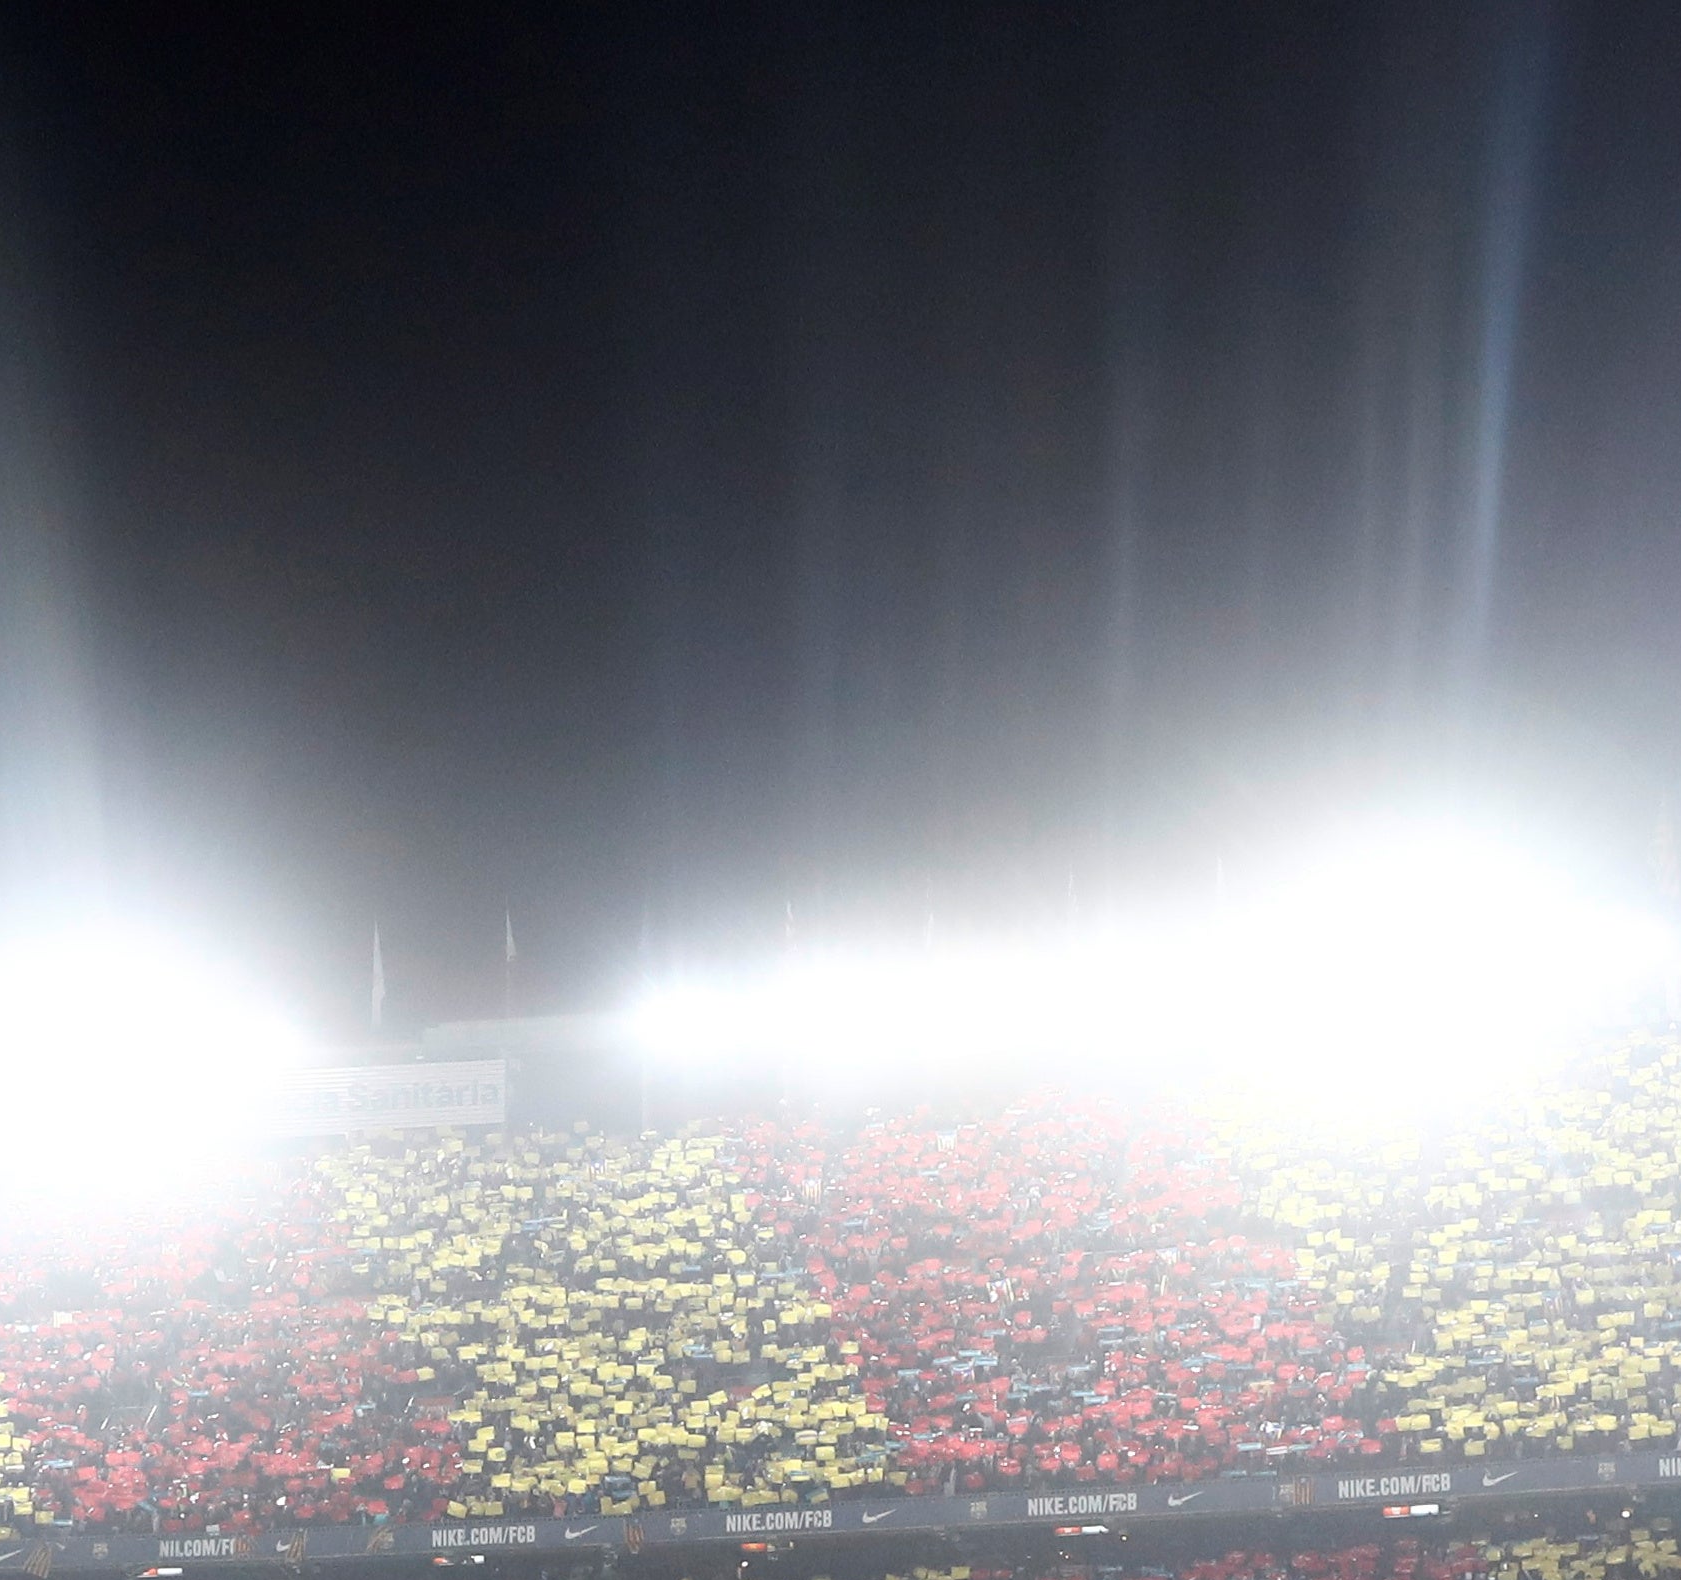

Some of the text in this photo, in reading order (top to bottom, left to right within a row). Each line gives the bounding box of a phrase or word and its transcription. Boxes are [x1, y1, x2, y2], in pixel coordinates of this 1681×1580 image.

[1337, 1472, 1451, 1499] NIKE.COM/FCB
[1027, 1493, 1137, 1516] NIKE.COM/FCB
[726, 1510, 832, 1532] NIKE.COM/FCB
[431, 1526, 536, 1547] NIKE.COM/FCB
